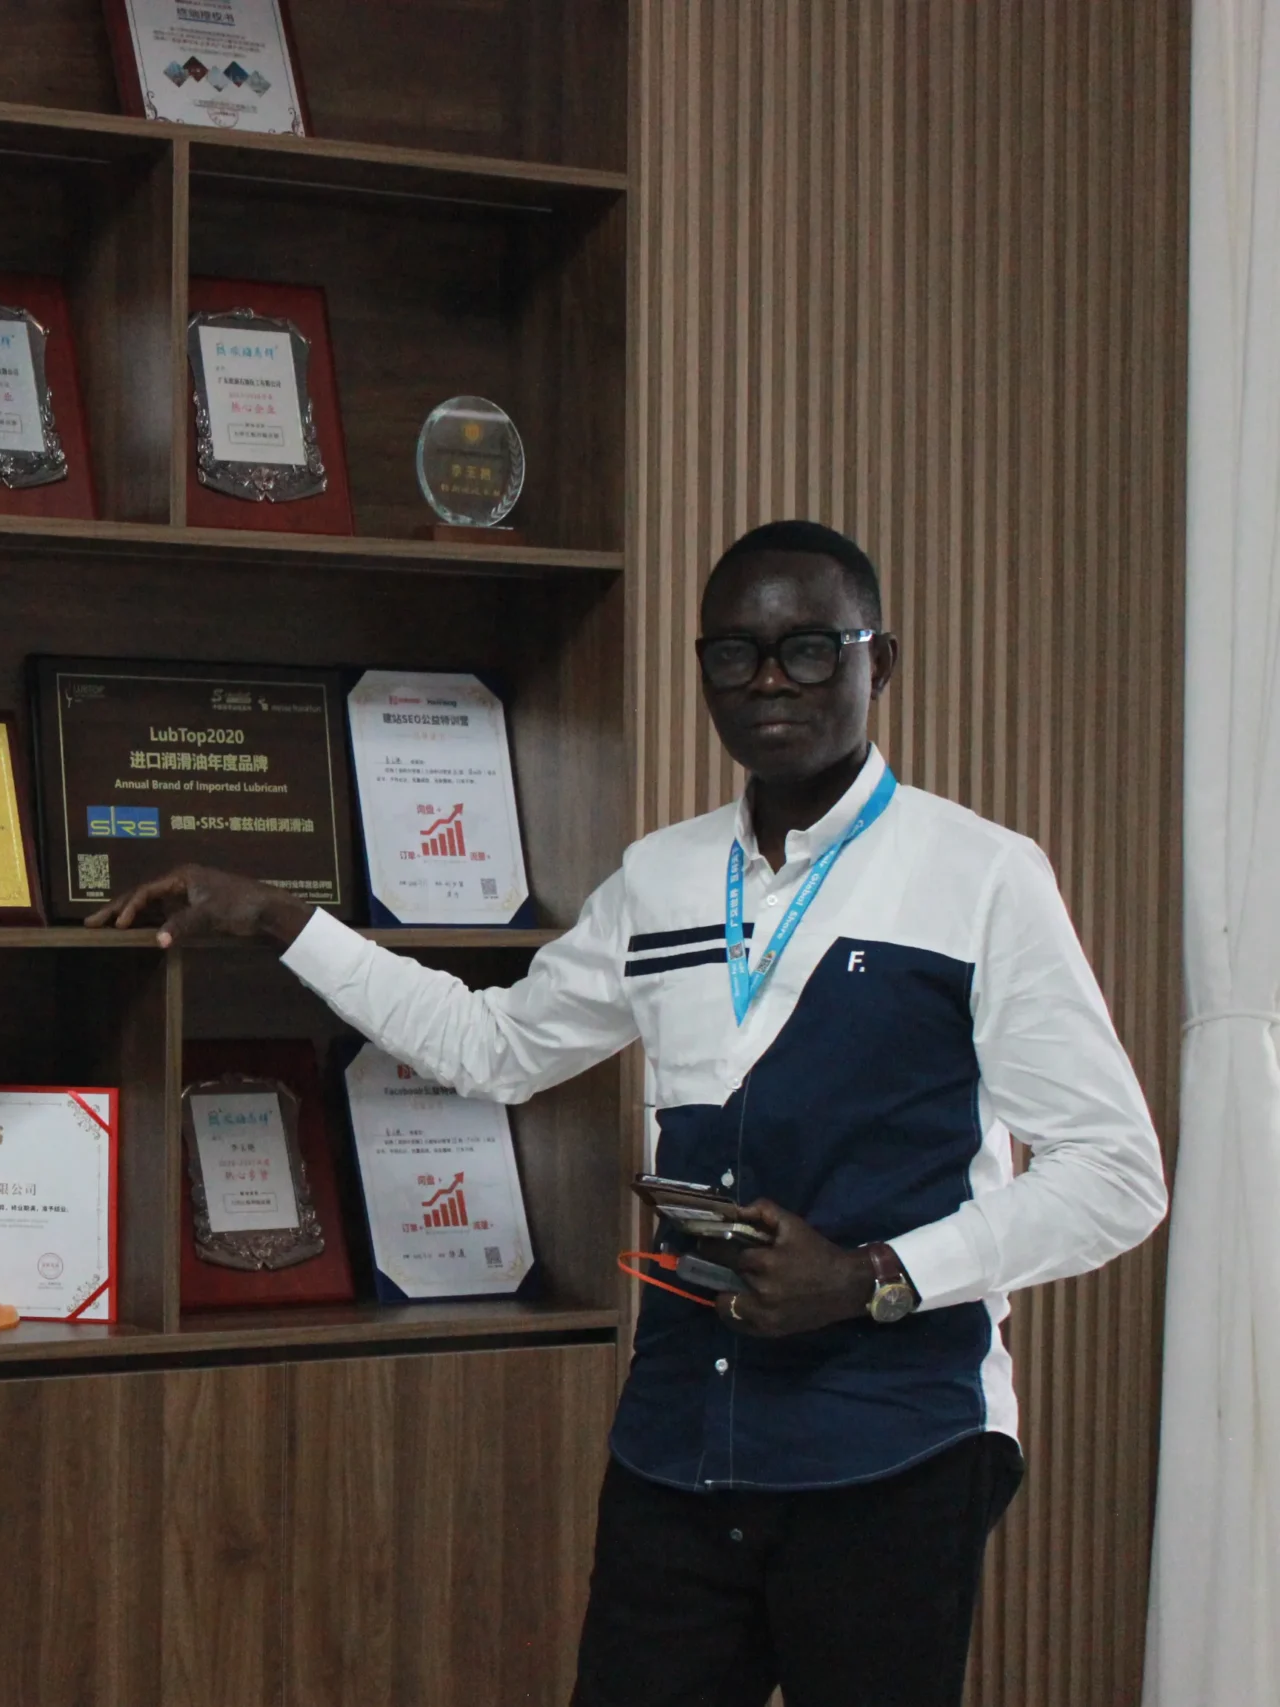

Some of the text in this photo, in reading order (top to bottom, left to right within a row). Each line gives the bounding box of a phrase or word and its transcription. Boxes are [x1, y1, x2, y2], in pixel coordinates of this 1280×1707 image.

[382, 712, 469, 727] 建站SEO公益特训营
[150, 727, 245, 747] LubTop2020
[130, 751, 269, 773] 进口润滑油年度品牌
[115, 779, 288, 793] Annual Brand of Imported Lubricant
[795, 872, 820, 907] Global
[776, 908, 798, 940] Share
